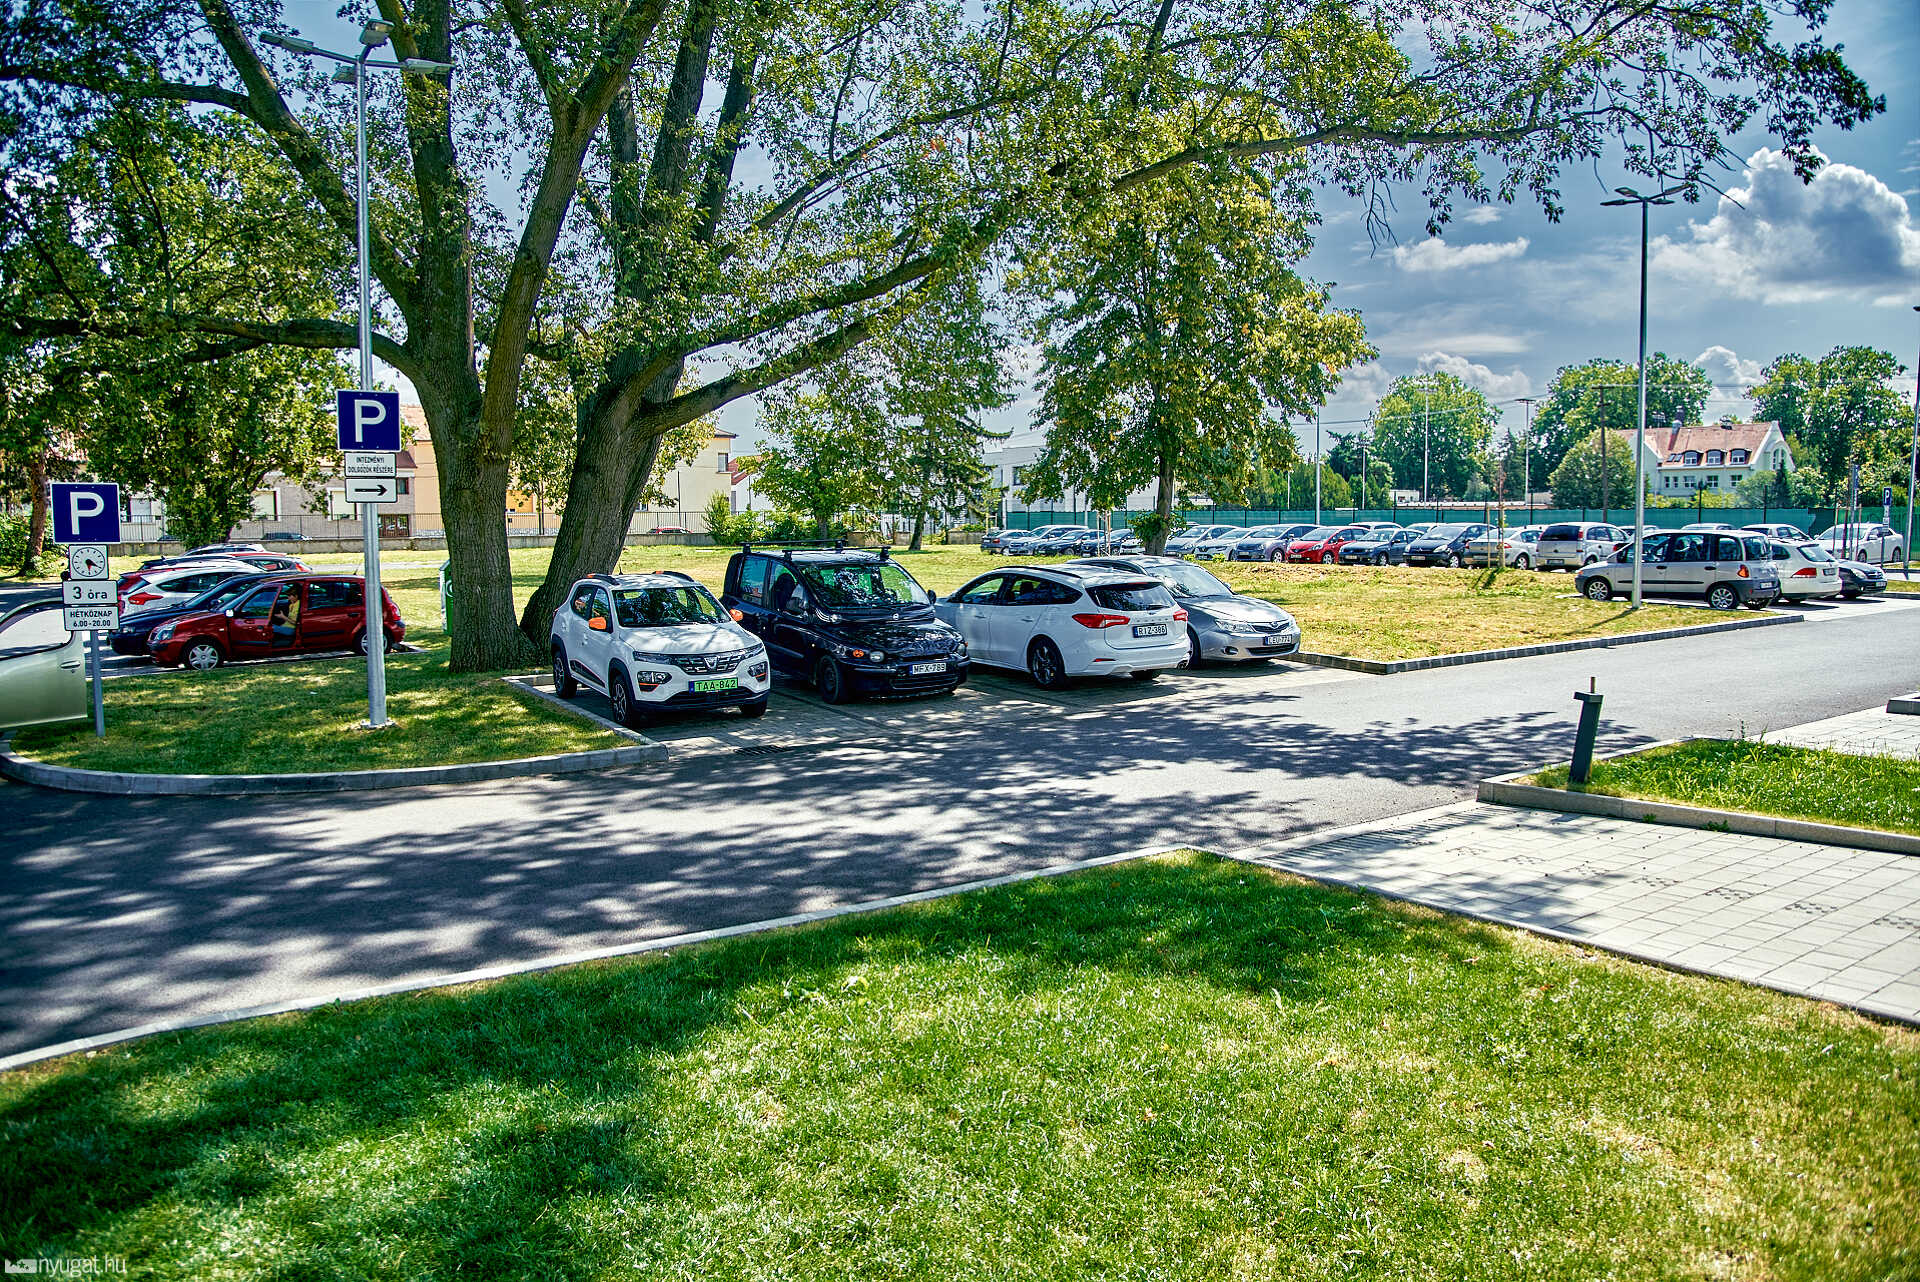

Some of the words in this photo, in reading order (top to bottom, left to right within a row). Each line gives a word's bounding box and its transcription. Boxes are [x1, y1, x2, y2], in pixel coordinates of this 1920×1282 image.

[354, 399, 386, 442] P
[70, 491, 104, 535] P
[72, 586, 82, 599] 3
[87, 589, 108, 599] óra
[695, 679, 736, 691] TAA-842
